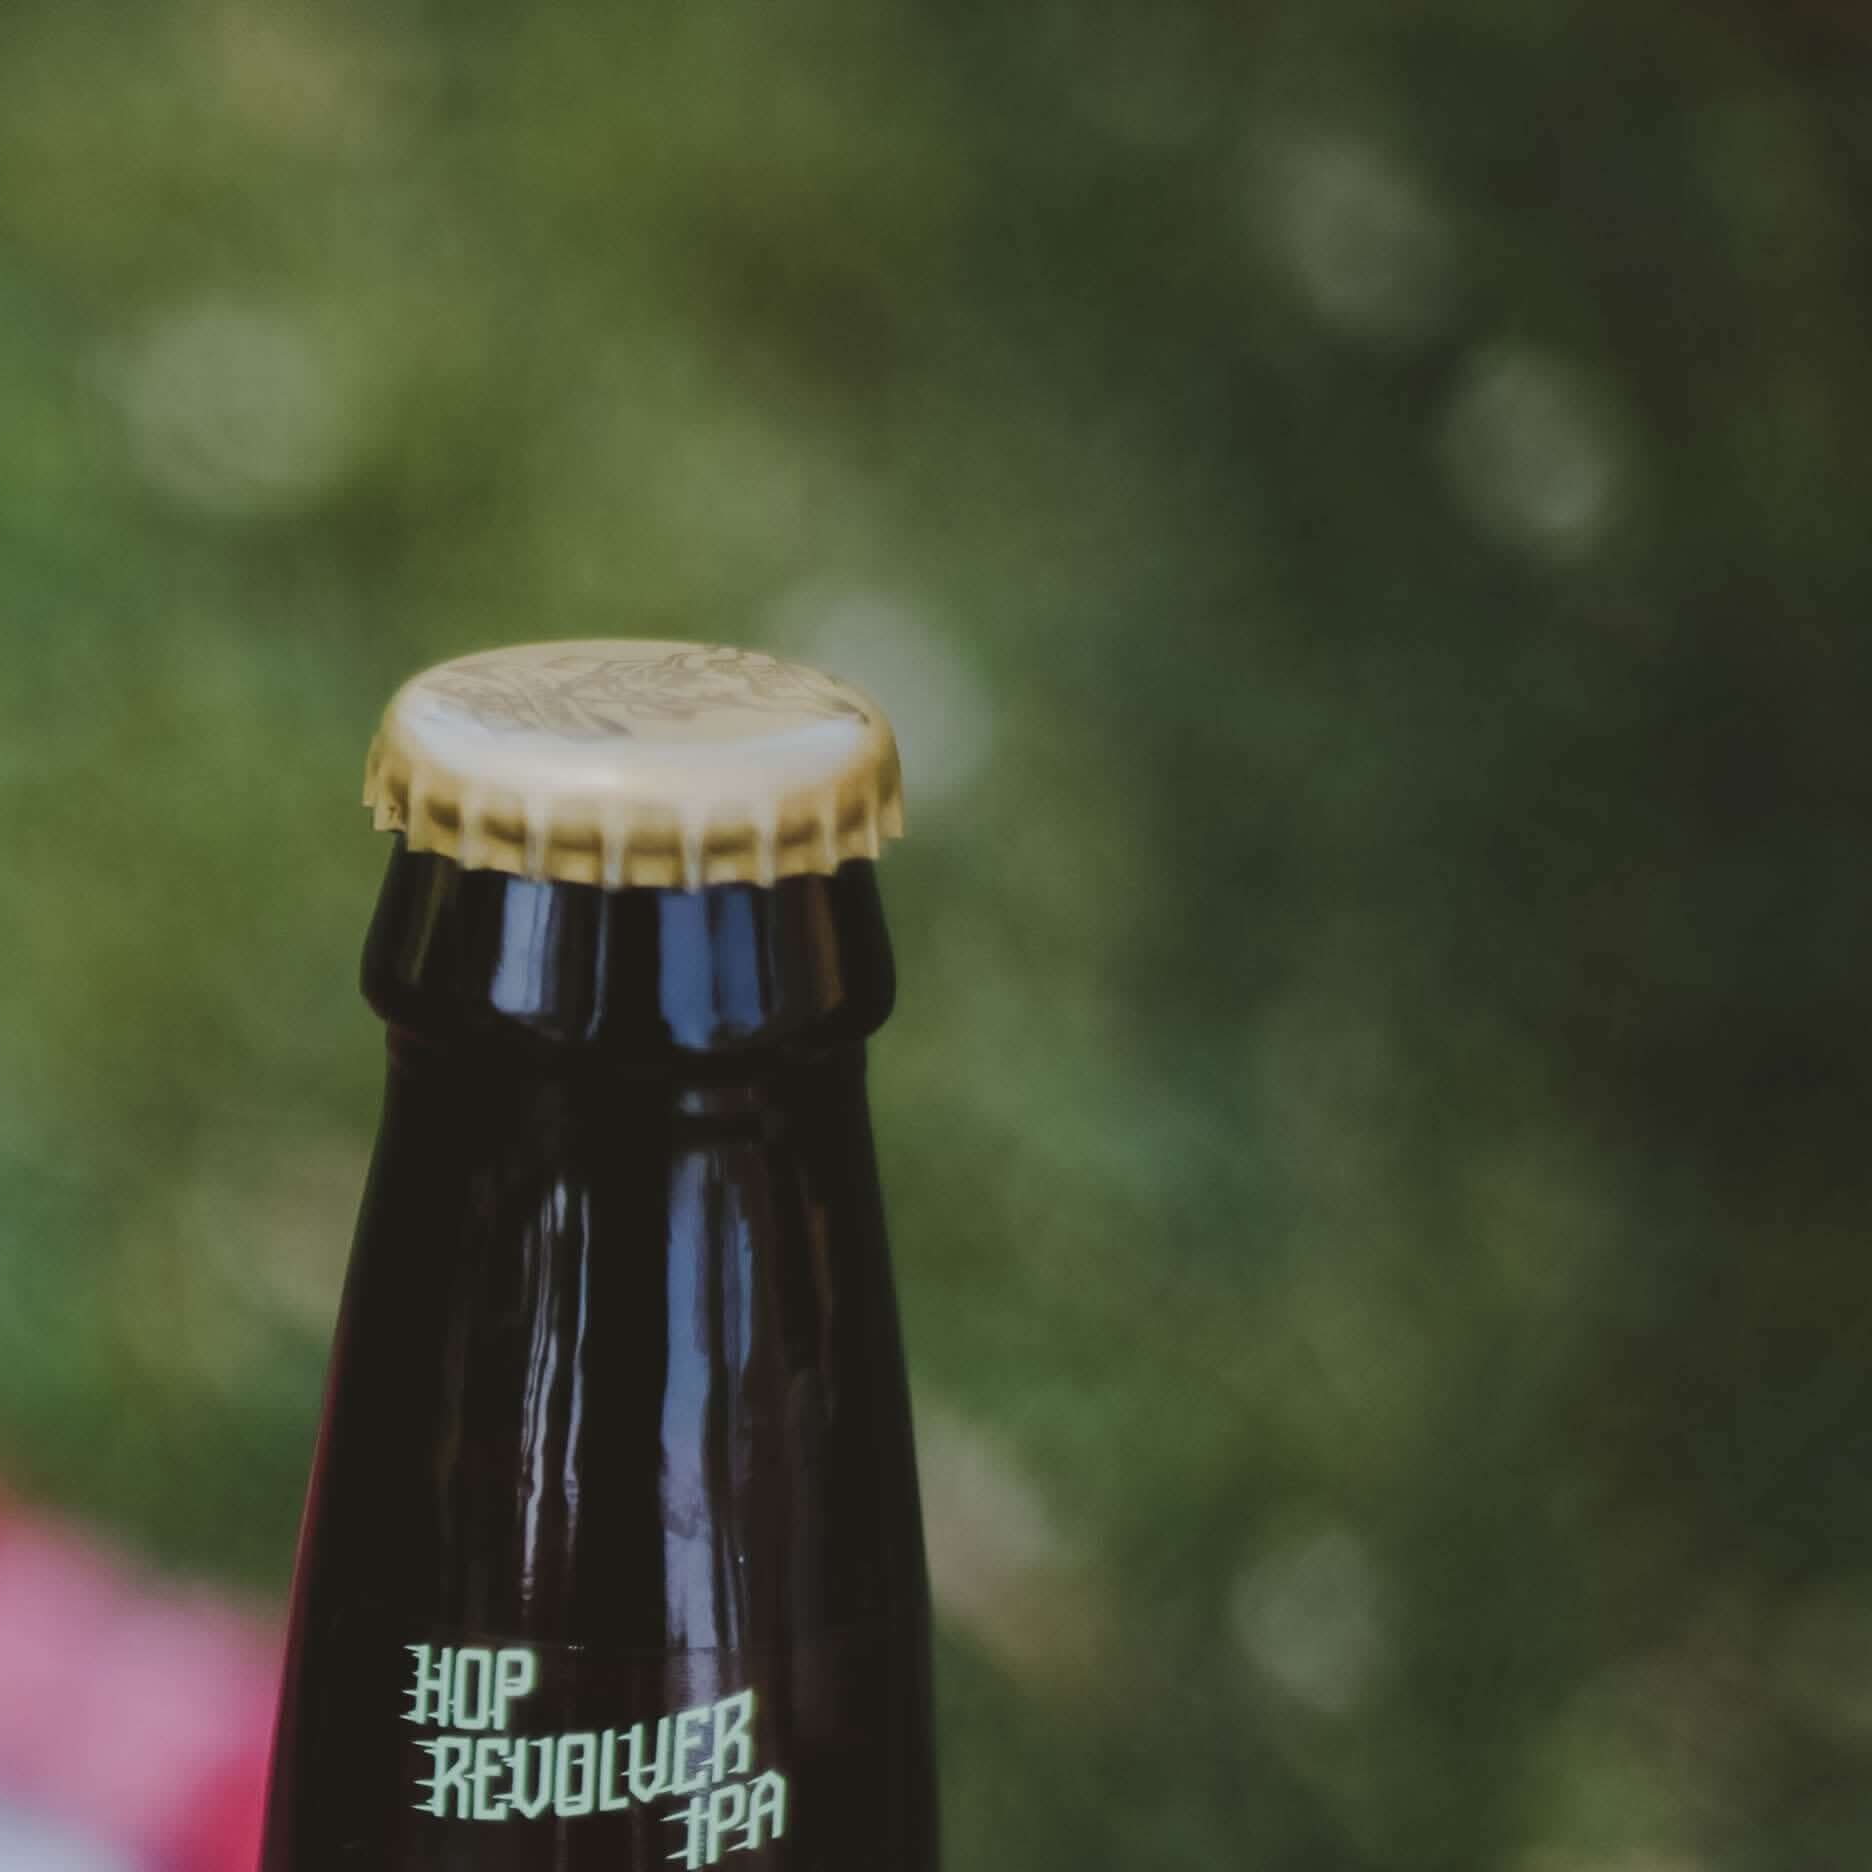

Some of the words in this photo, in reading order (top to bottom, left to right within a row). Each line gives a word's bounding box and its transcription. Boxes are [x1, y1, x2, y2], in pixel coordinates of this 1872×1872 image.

[400, 1643, 536, 1731] HOP
[411, 1687, 755, 1821] REVOLVER
[659, 1769, 787, 1871] IPA
